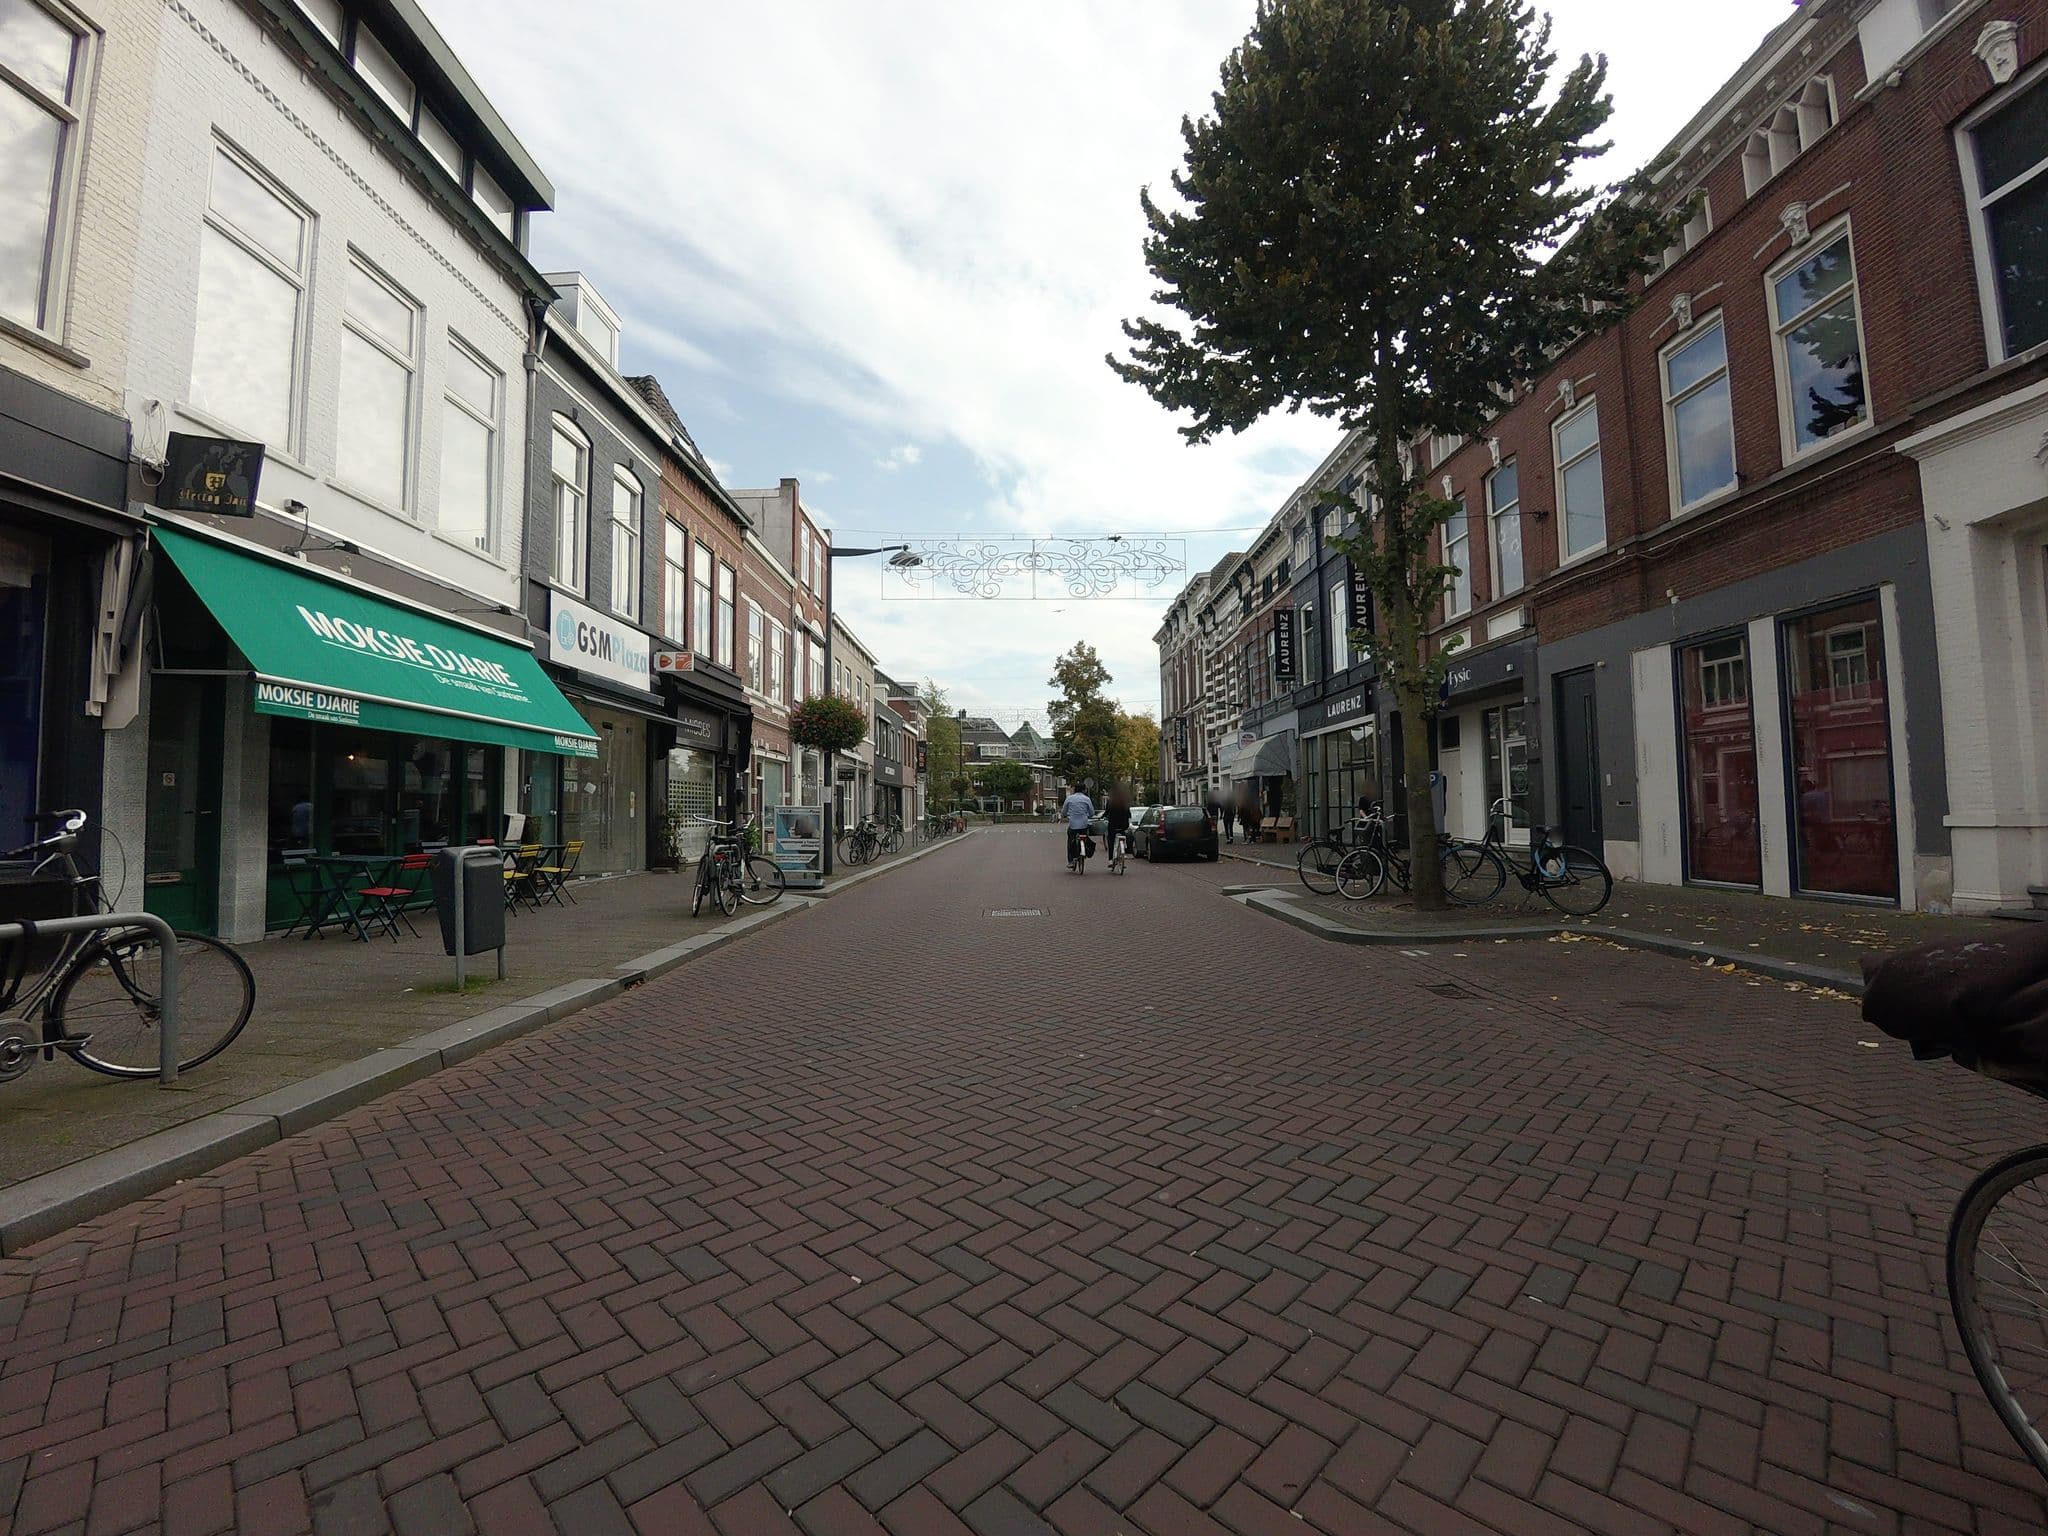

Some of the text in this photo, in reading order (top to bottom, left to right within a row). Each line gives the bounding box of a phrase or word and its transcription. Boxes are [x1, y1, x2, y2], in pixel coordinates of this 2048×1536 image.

[296, 605, 519, 688] MOKSIE DJARIE
[1280, 613, 1290, 673] LAURENZ
[258, 683, 360, 715] MOKSIE DJARIE
[1328, 695, 1361, 717] LAURENZ
[555, 735, 598, 751] MOKSIE DJARIE
